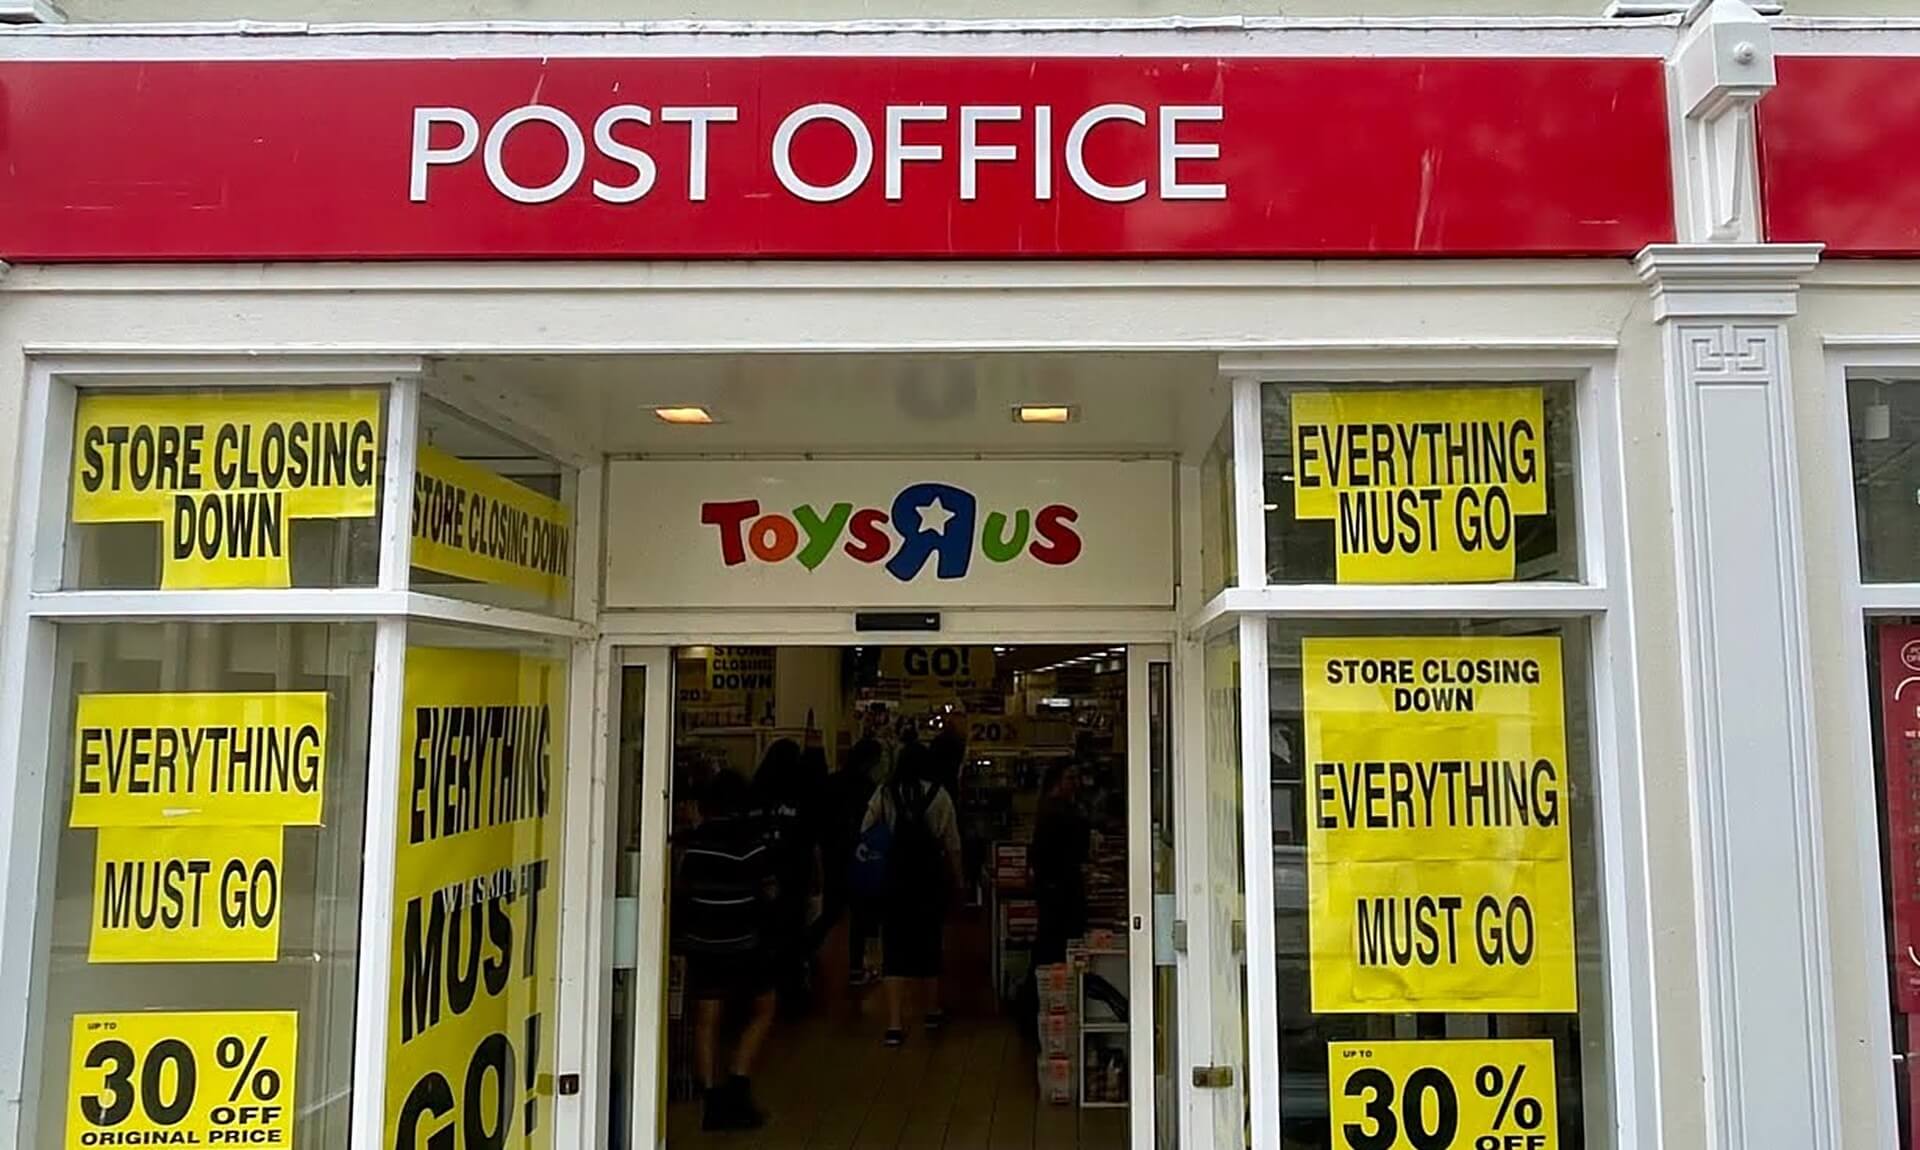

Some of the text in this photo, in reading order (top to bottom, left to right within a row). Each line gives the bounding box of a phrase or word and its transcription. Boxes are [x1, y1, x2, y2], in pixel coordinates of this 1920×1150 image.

[409, 103, 1229, 204] POST OFFICE
[82, 420, 374, 492] STORE CLOSING
[1298, 420, 1537, 488] EVERYTHING
[174, 492, 281, 560] DOWN
[411, 471, 569, 576] STORE CLOSING DOWN
[1339, 486, 1511, 554] MUST GO
[713, 674, 772, 690] DOWN
[904, 646, 970, 676] GO!
[1327, 660, 1540, 684] STORE CLOSING
[1395, 688, 1474, 712] DOWN
[79, 725, 320, 794] EVERYTHING
[410, 703, 551, 844] EVERYTHING
[1314, 759, 1559, 829] EVERYTHING
[102, 859, 277, 929] MUST GO
[402, 859, 548, 1045] MUST
[1358, 896, 1534, 966] MUST GO
[88, 1022, 117, 1030] UP TO
[1343, 1050, 1373, 1058] UP TO
[80, 1039, 197, 1127] 30
[394, 1012, 542, 1150] GO!
[1343, 1067, 1458, 1150] 30
[81, 1130, 282, 1145] ORIGINAL PRICE
[210, 1107, 282, 1125] OFF
[1475, 1136, 1546, 1150] OFF
